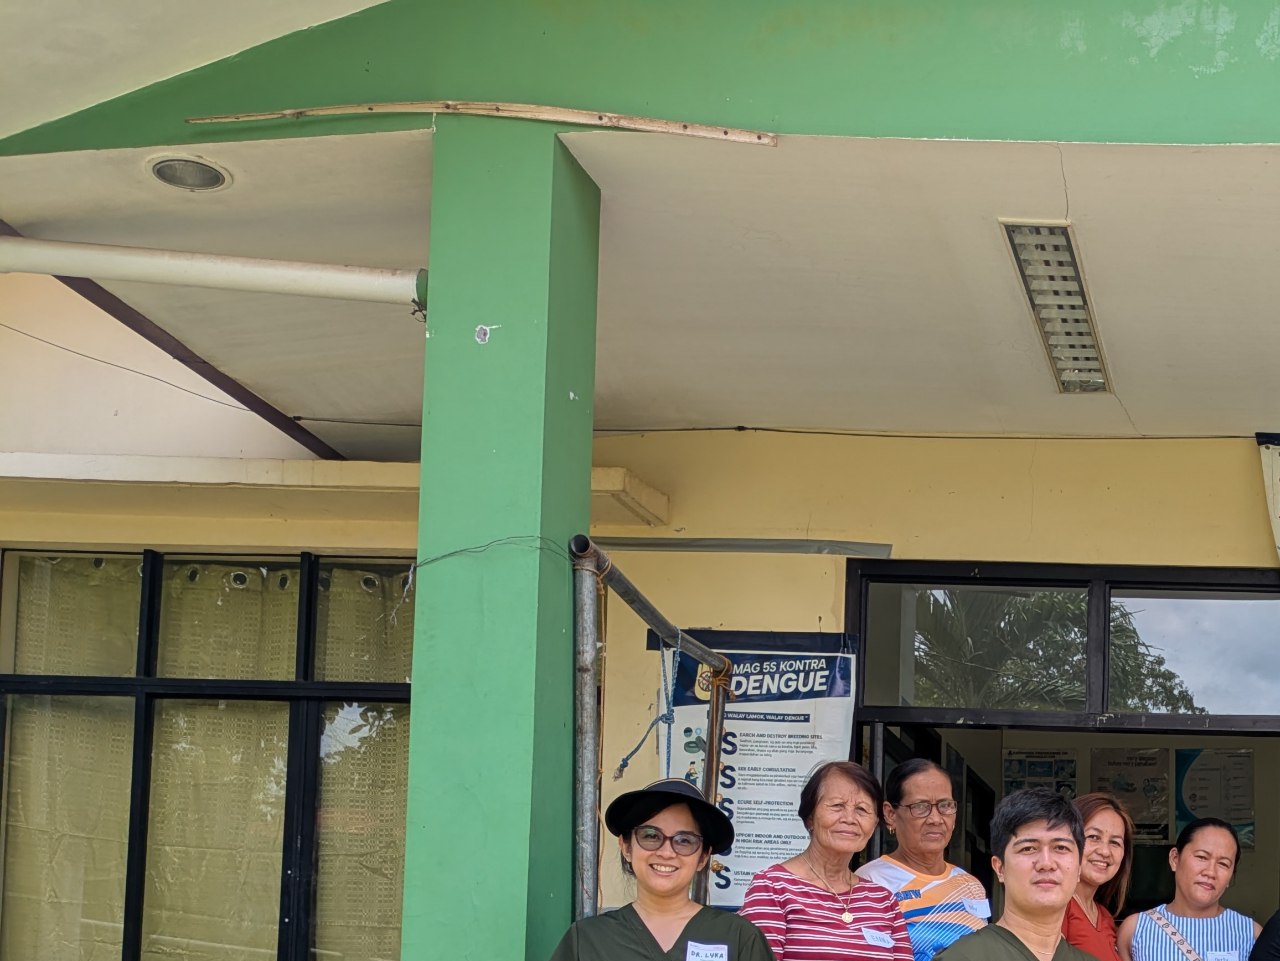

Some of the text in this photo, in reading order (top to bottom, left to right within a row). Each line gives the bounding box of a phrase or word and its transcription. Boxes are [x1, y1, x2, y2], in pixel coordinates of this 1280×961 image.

[733, 659, 826, 674] MAG 5S KONTRA
[730, 670, 829, 695] DENGUE
